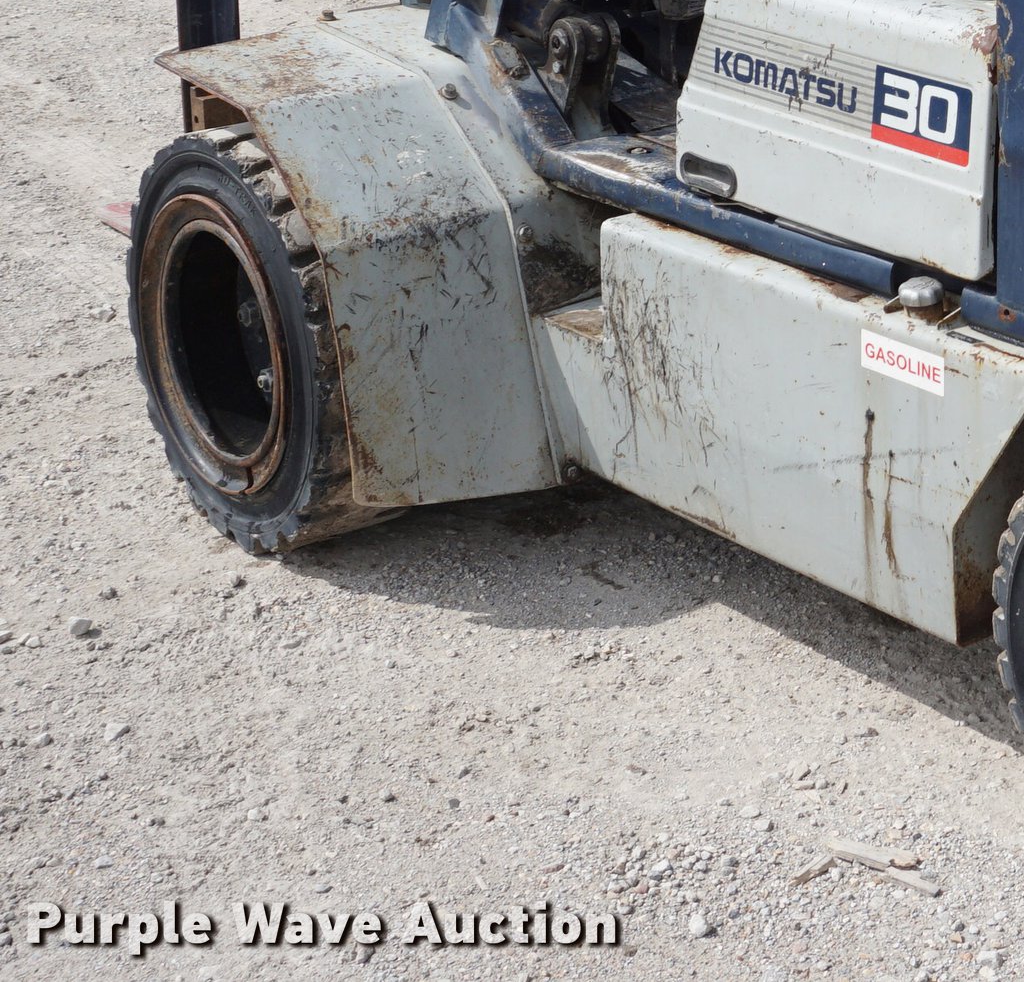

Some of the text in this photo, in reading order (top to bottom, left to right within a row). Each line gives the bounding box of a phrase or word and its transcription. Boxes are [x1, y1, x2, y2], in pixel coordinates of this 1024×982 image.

[714, 47, 857, 114] KOMATSU
[880, 72, 959, 145] 30
[865, 343, 941, 384] GASOLINE
